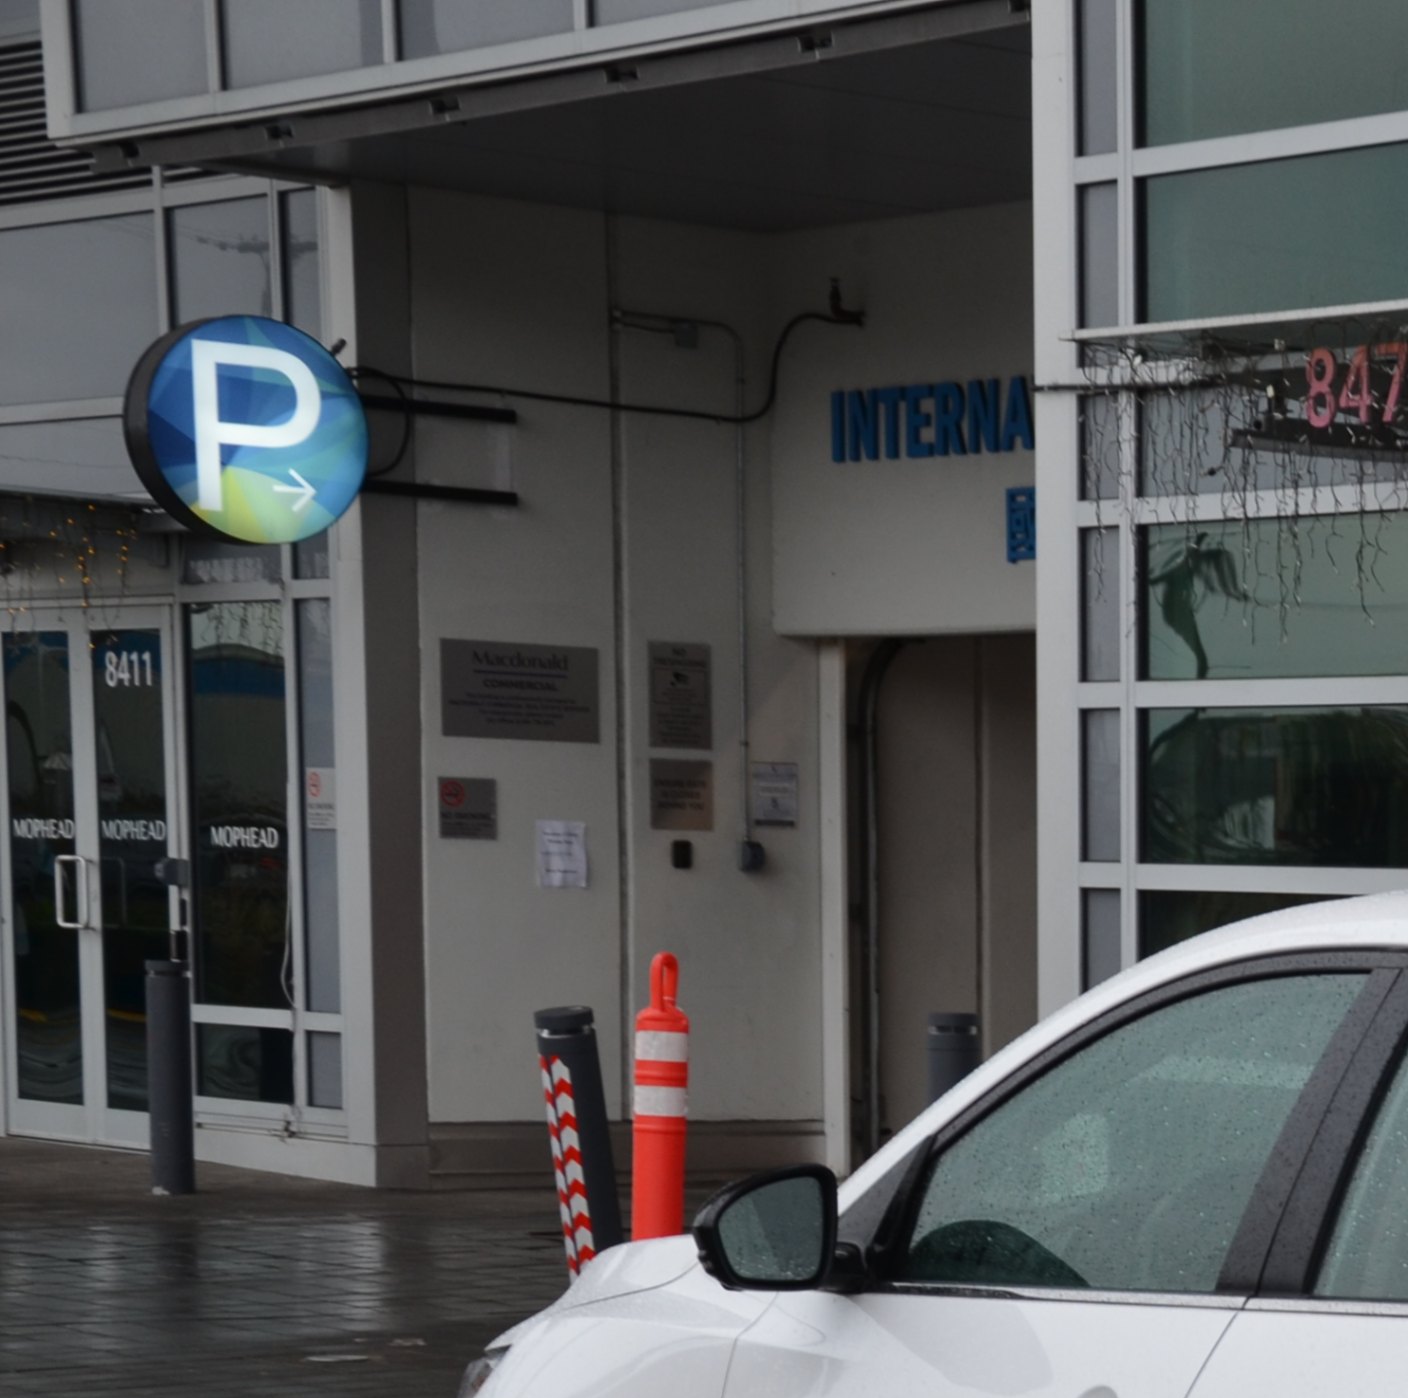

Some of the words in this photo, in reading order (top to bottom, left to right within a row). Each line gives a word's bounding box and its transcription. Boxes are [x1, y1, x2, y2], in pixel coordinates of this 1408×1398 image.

[190, 338, 322, 512] P
[831, 375, 1035, 463] INTERNA
[104, 650, 153, 688] 8411
[471, 649, 569, 671] Macdonald
[482, 679, 559, 692] COMMERCIAL
[13, 818, 75, 840] MOPHEAD
[101, 819, 166, 841] MOPHEAD
[210, 825, 279, 848] MOPHEAD
